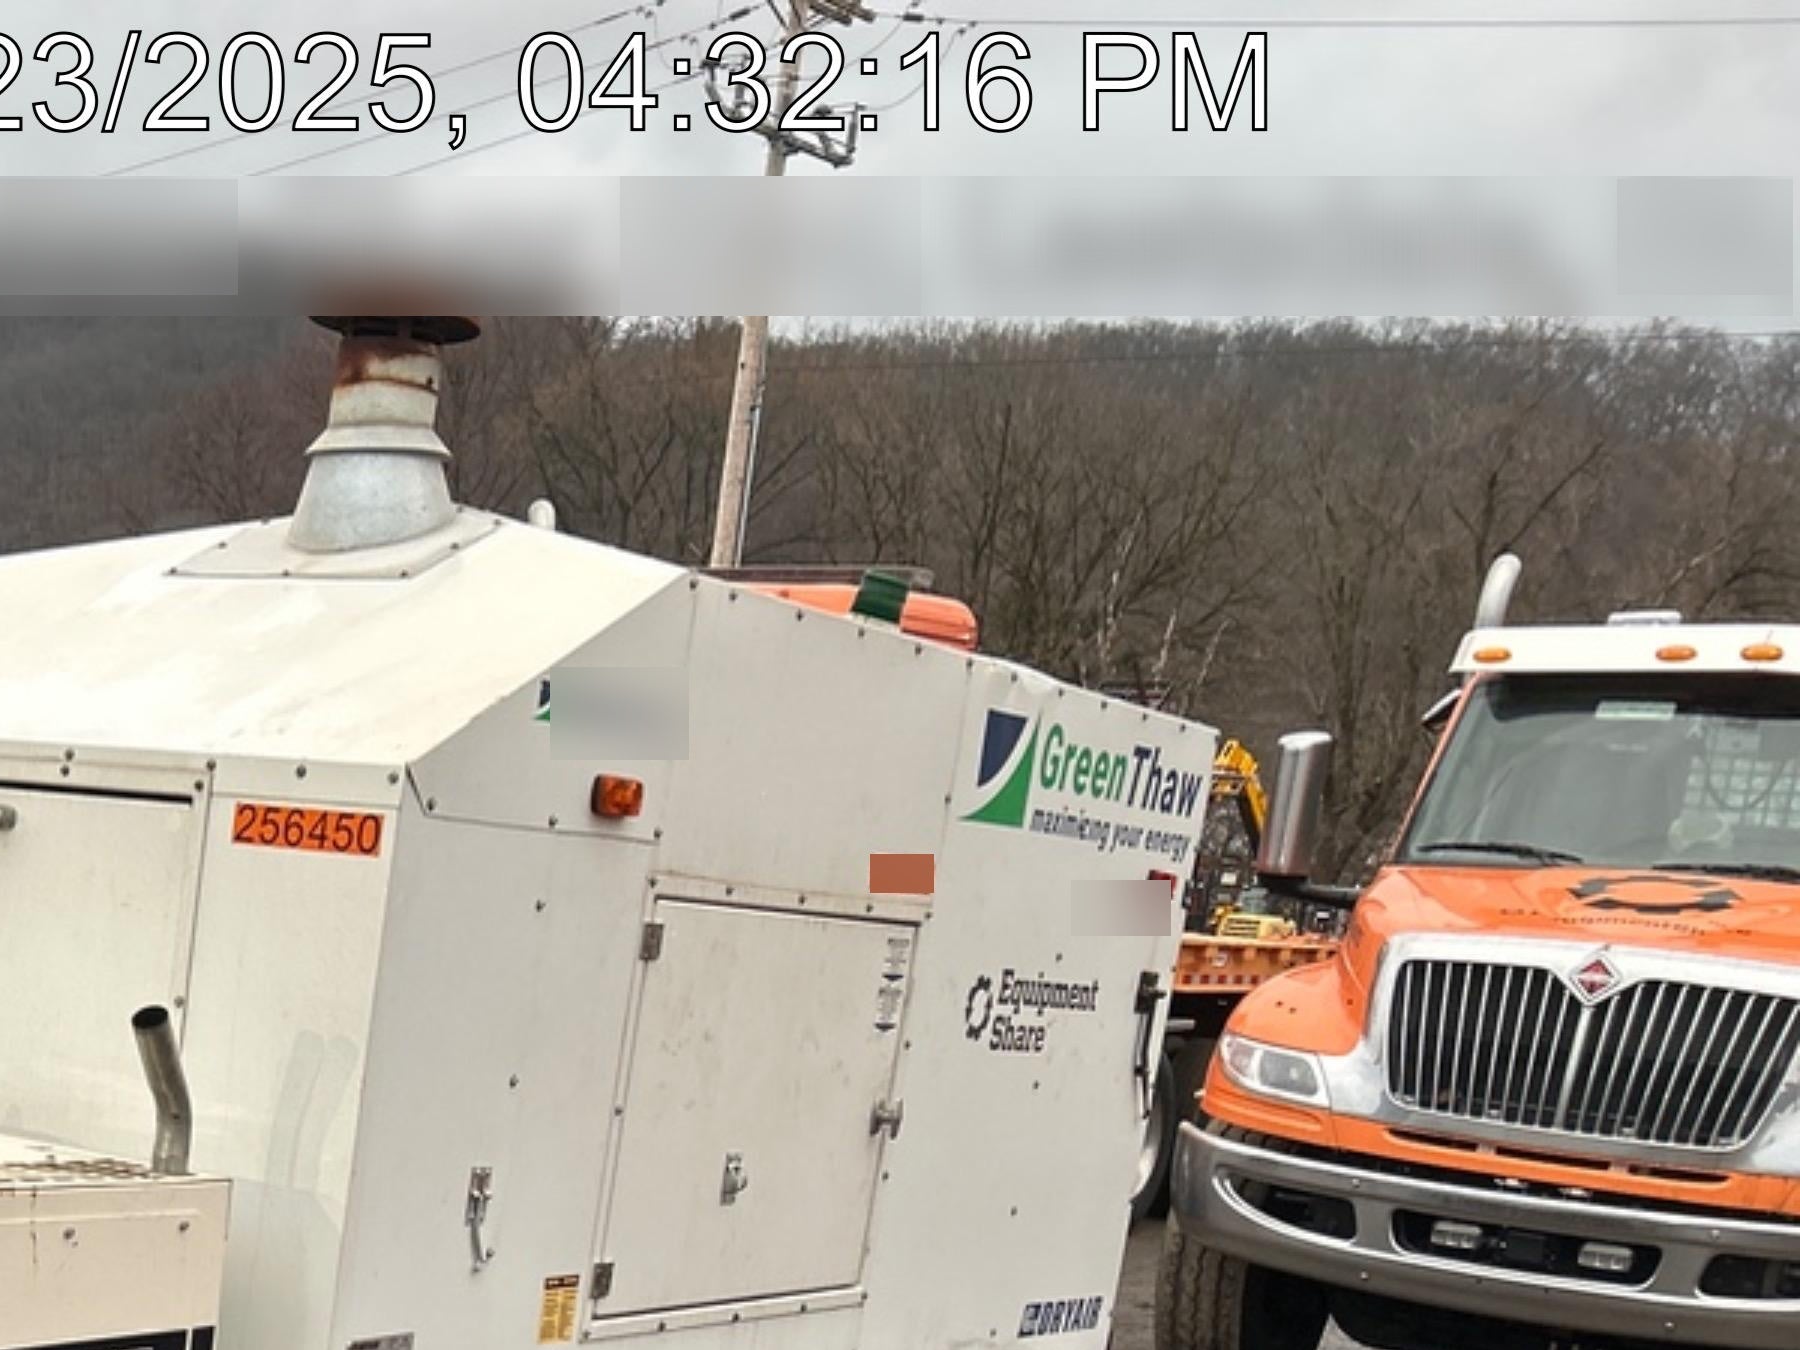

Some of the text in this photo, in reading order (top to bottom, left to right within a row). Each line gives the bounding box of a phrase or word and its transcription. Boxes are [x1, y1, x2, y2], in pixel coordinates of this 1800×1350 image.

[233, 804, 382, 855] 256450
[1110, 823, 1144, 853] your
[1144, 825, 1192, 863] energy
[998, 968, 1099, 1017] Equipment
[990, 1014, 1045, 1053] Share
